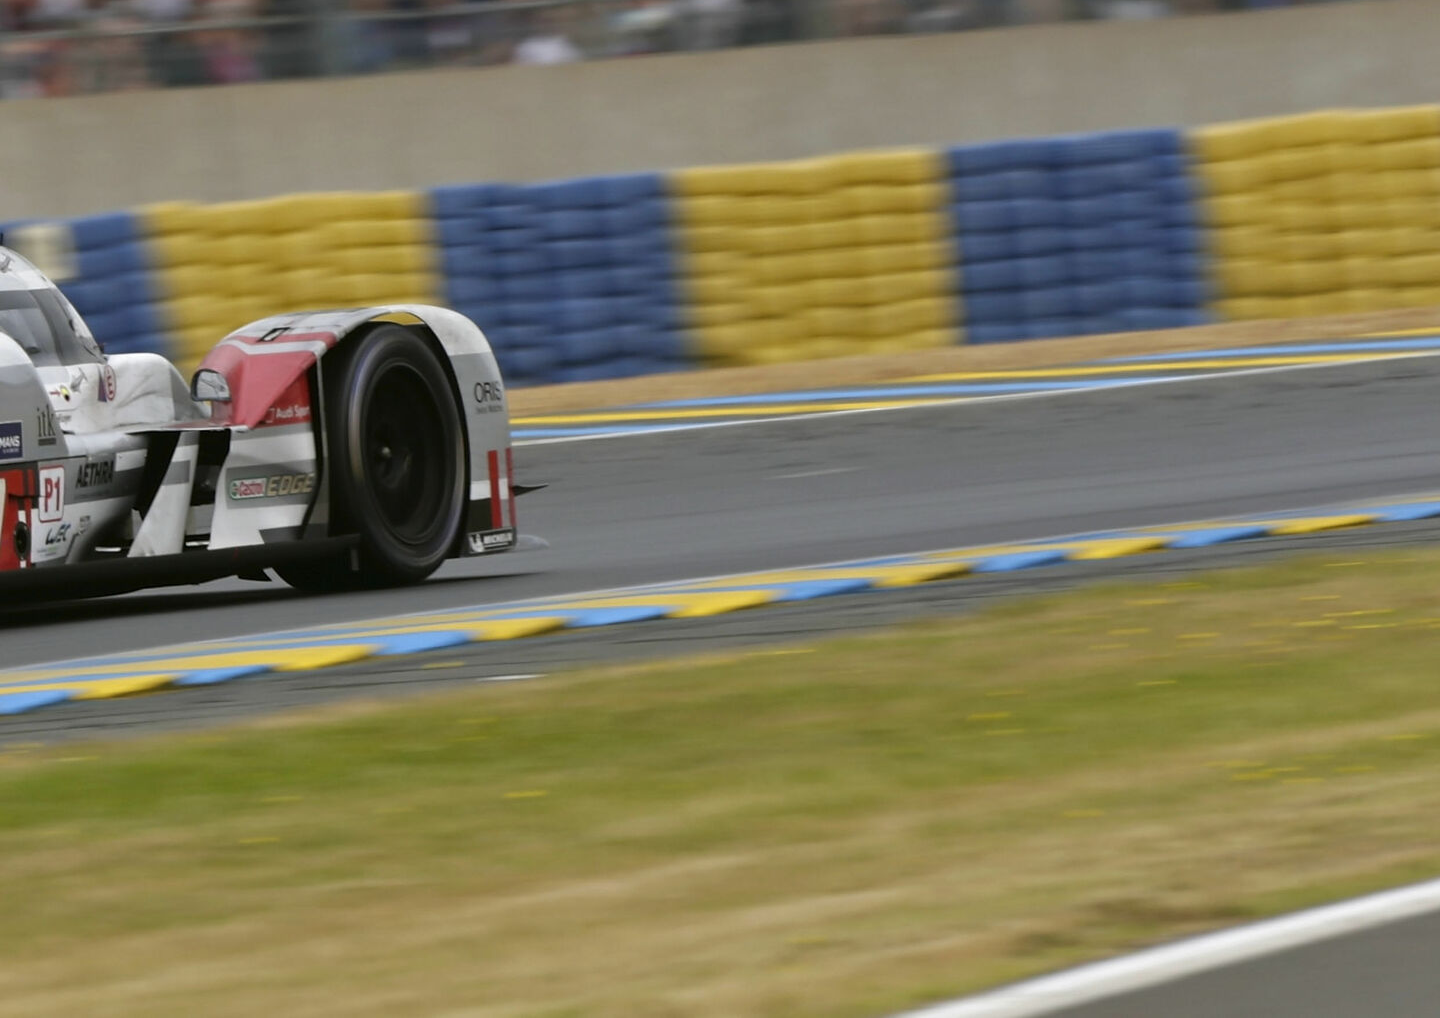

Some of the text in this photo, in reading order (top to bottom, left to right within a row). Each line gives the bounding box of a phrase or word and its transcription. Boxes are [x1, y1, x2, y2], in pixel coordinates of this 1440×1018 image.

[474, 381, 502, 403] ORIS
[0, 435, 21, 449] MANS
[45, 476, 60, 513] P1
[267, 473, 315, 497] EDGE
